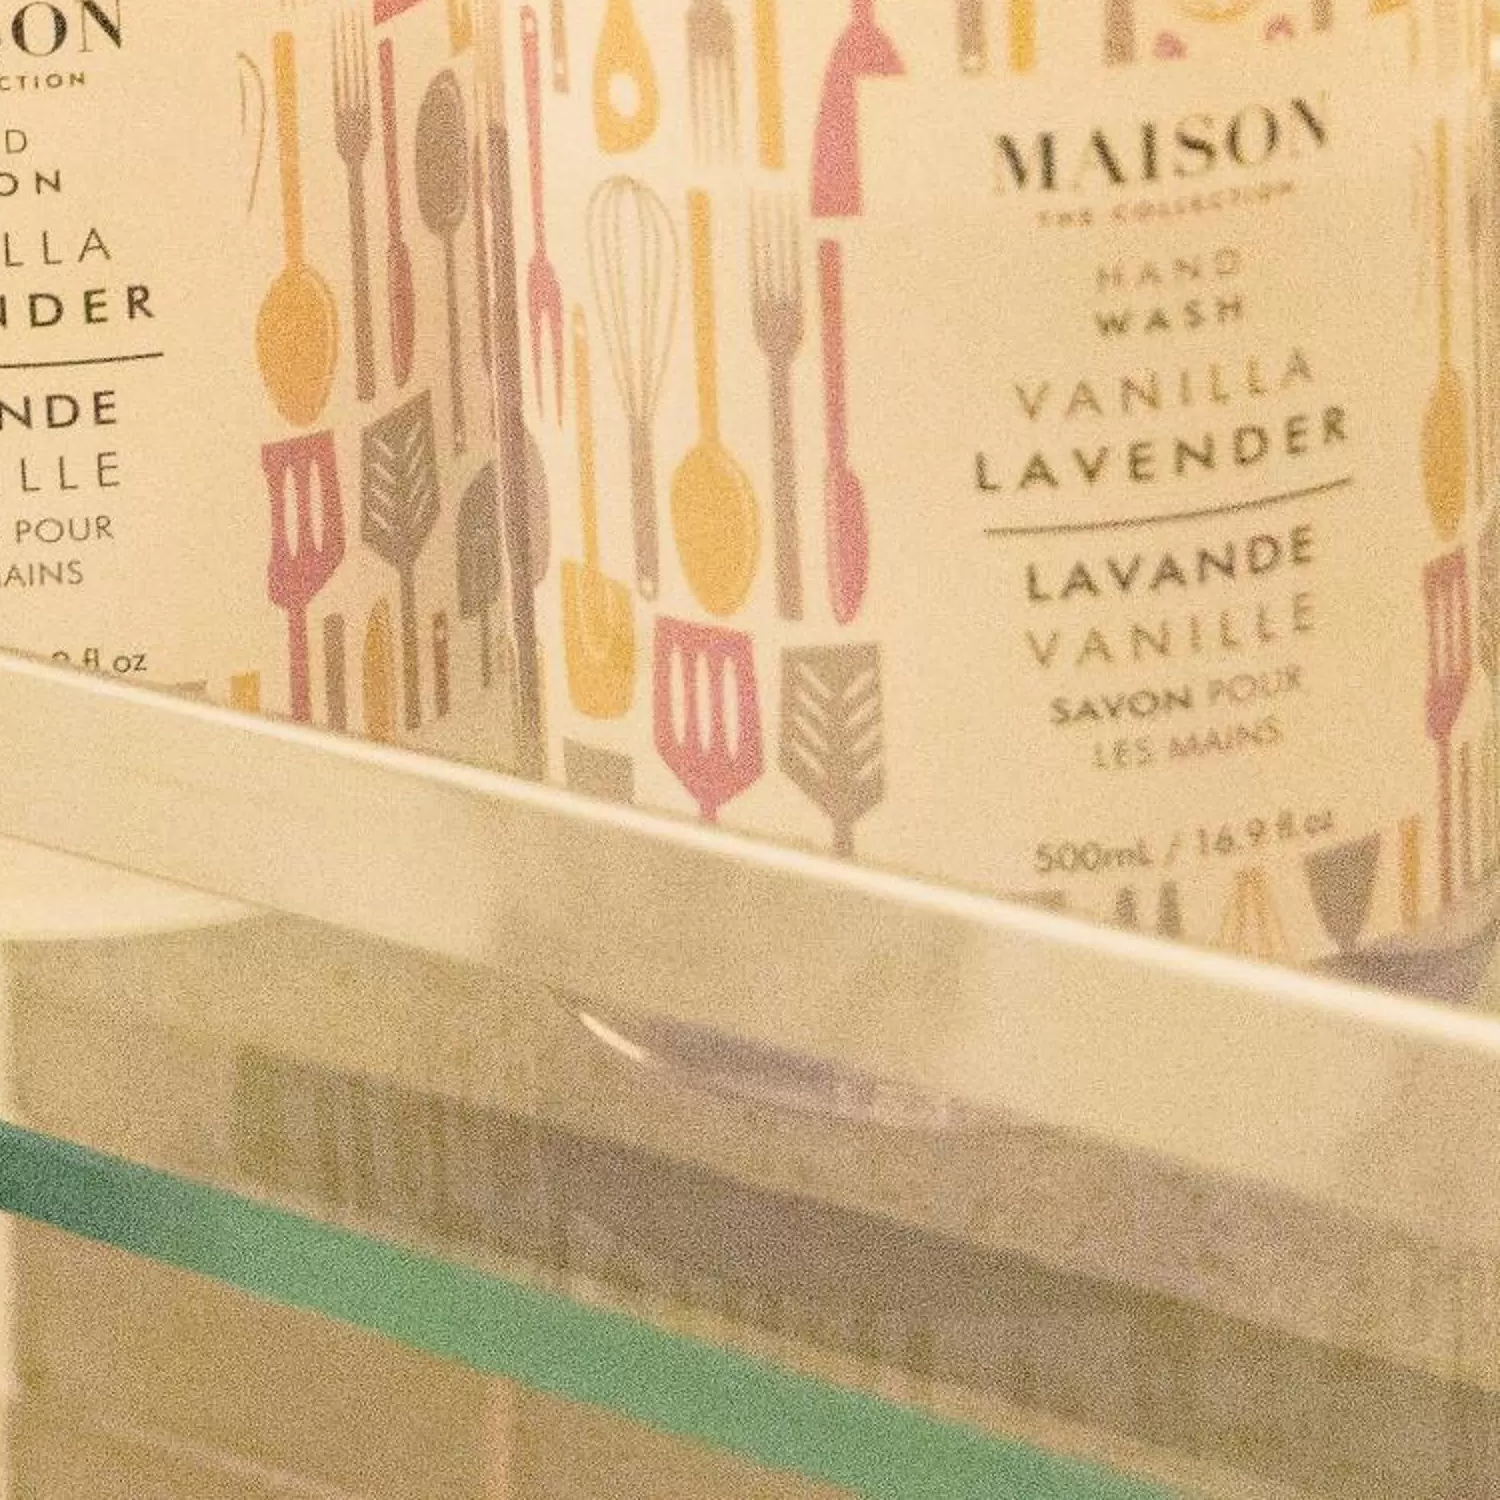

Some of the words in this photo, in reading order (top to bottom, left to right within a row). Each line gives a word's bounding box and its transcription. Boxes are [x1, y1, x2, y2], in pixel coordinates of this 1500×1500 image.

[994, 89, 1331, 194] MAISON
[1097, 247, 1241, 287] HAND
[1096, 296, 1242, 335] WASH
[1015, 346, 1313, 421] VANILLA
[975, 405, 1348, 492] LAVENDER
[15, 515, 114, 544] POUR
[1027, 524, 1313, 601] LAVANDE
[1026, 592, 1315, 668] VANILLE
[113, 652, 149, 674] oz
[1050, 685, 1193, 725] SAVON
[1207, 665, 1302, 706] POUR
[1093, 738, 1154, 770] LES
[1170, 716, 1282, 759] MAINS
